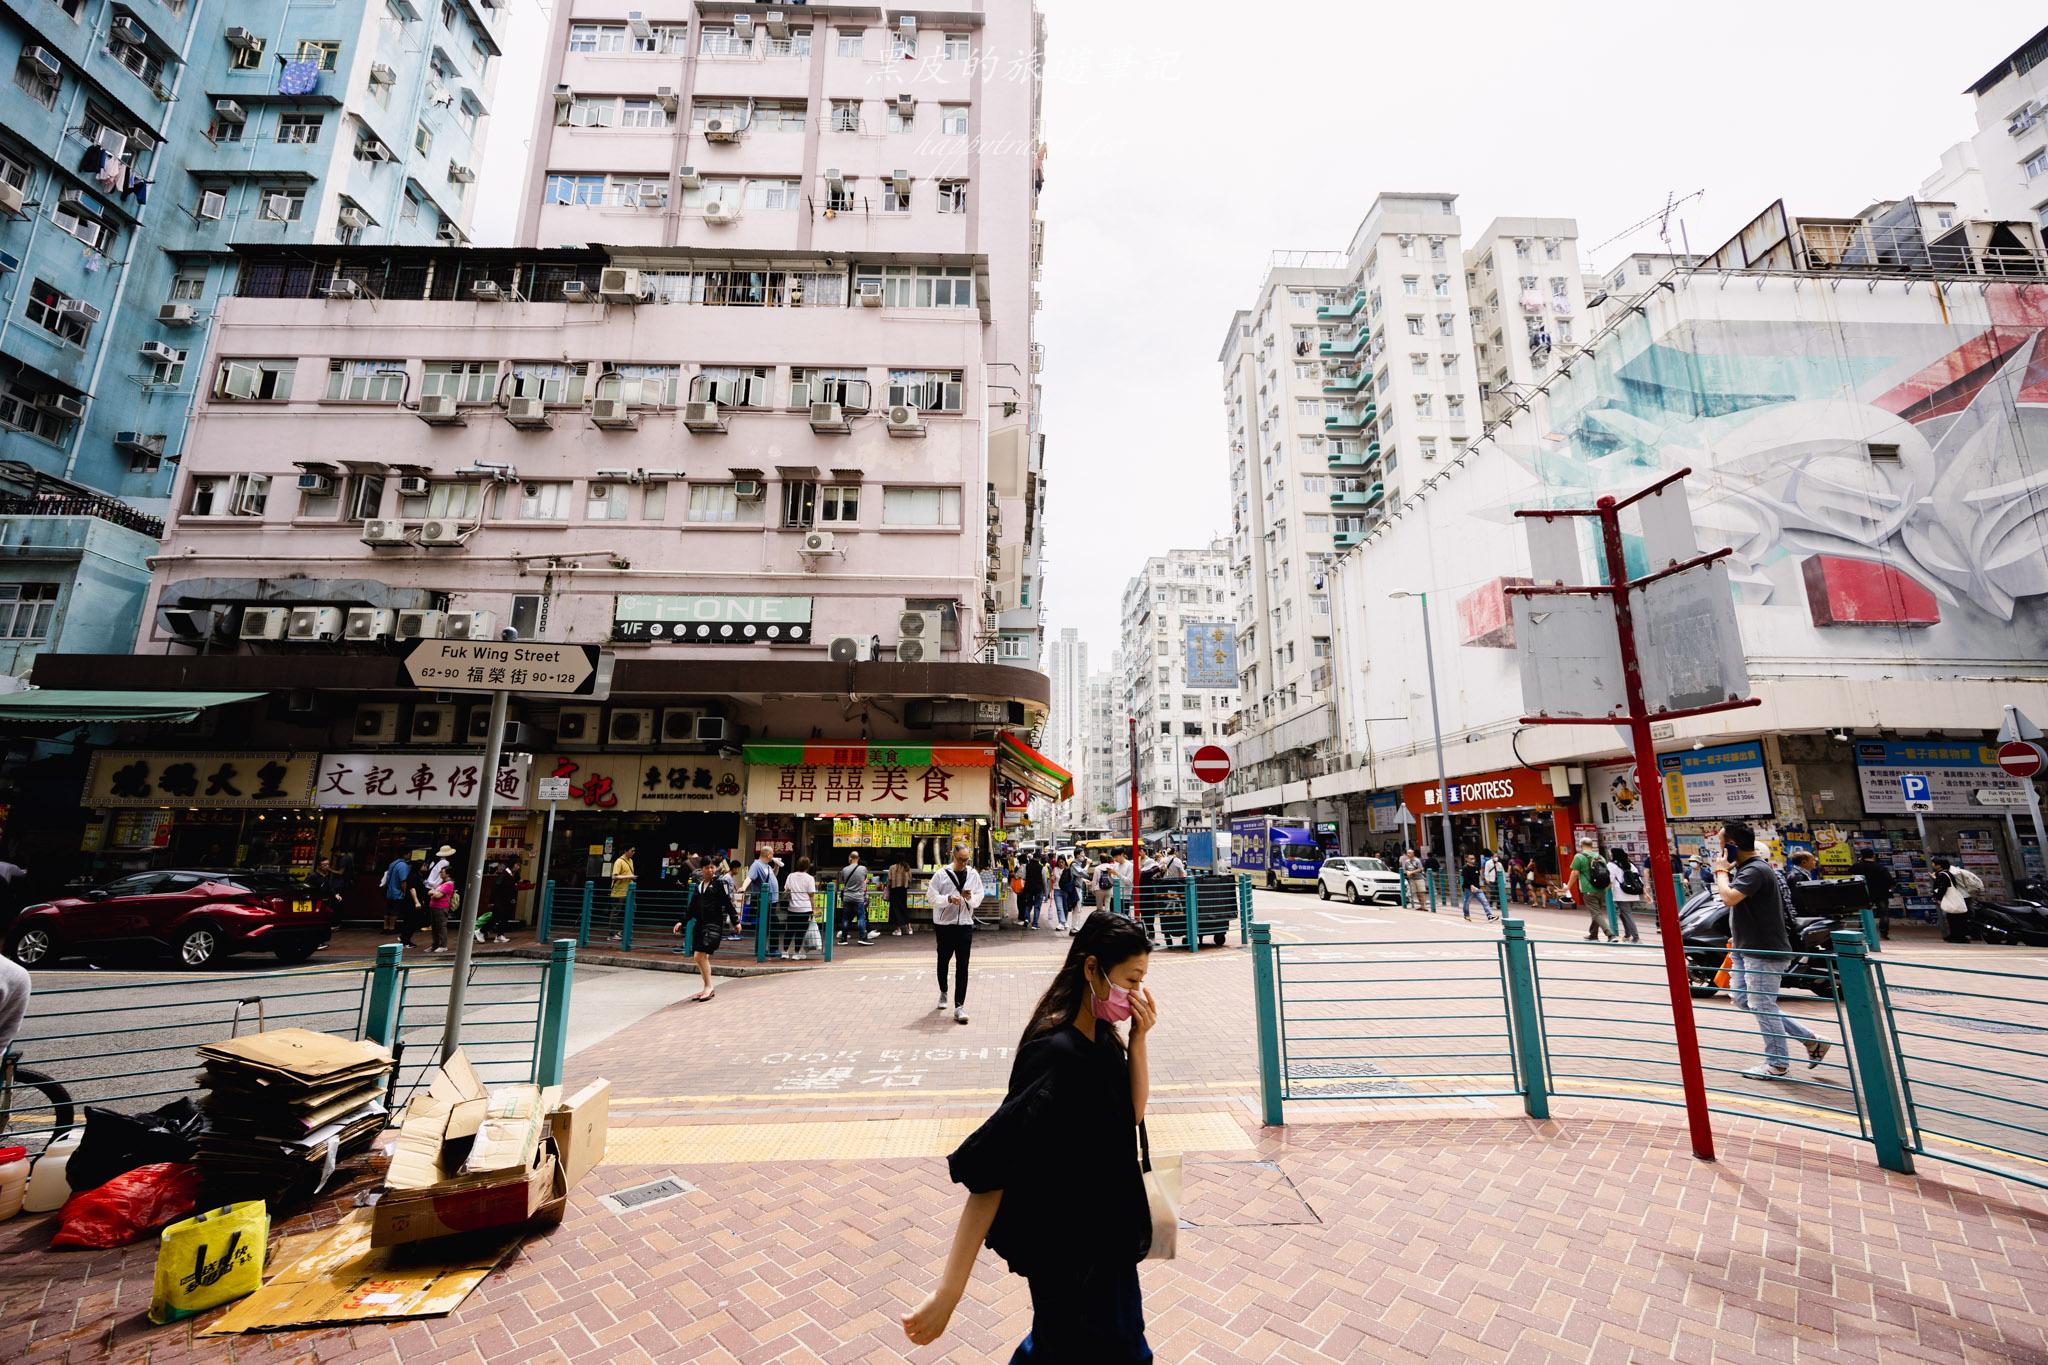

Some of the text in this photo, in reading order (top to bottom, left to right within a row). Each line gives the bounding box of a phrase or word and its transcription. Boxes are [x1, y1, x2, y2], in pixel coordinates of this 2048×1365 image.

[655, 598, 784, 620] i-ONE
[620, 622, 643, 635] 1/F
[441, 646, 560, 663] Fuk Wing Street
[466, 666, 528, 685] 福榮街
[1460, 778, 1514, 802] FORTRESS
[1905, 778, 1924, 798] P
